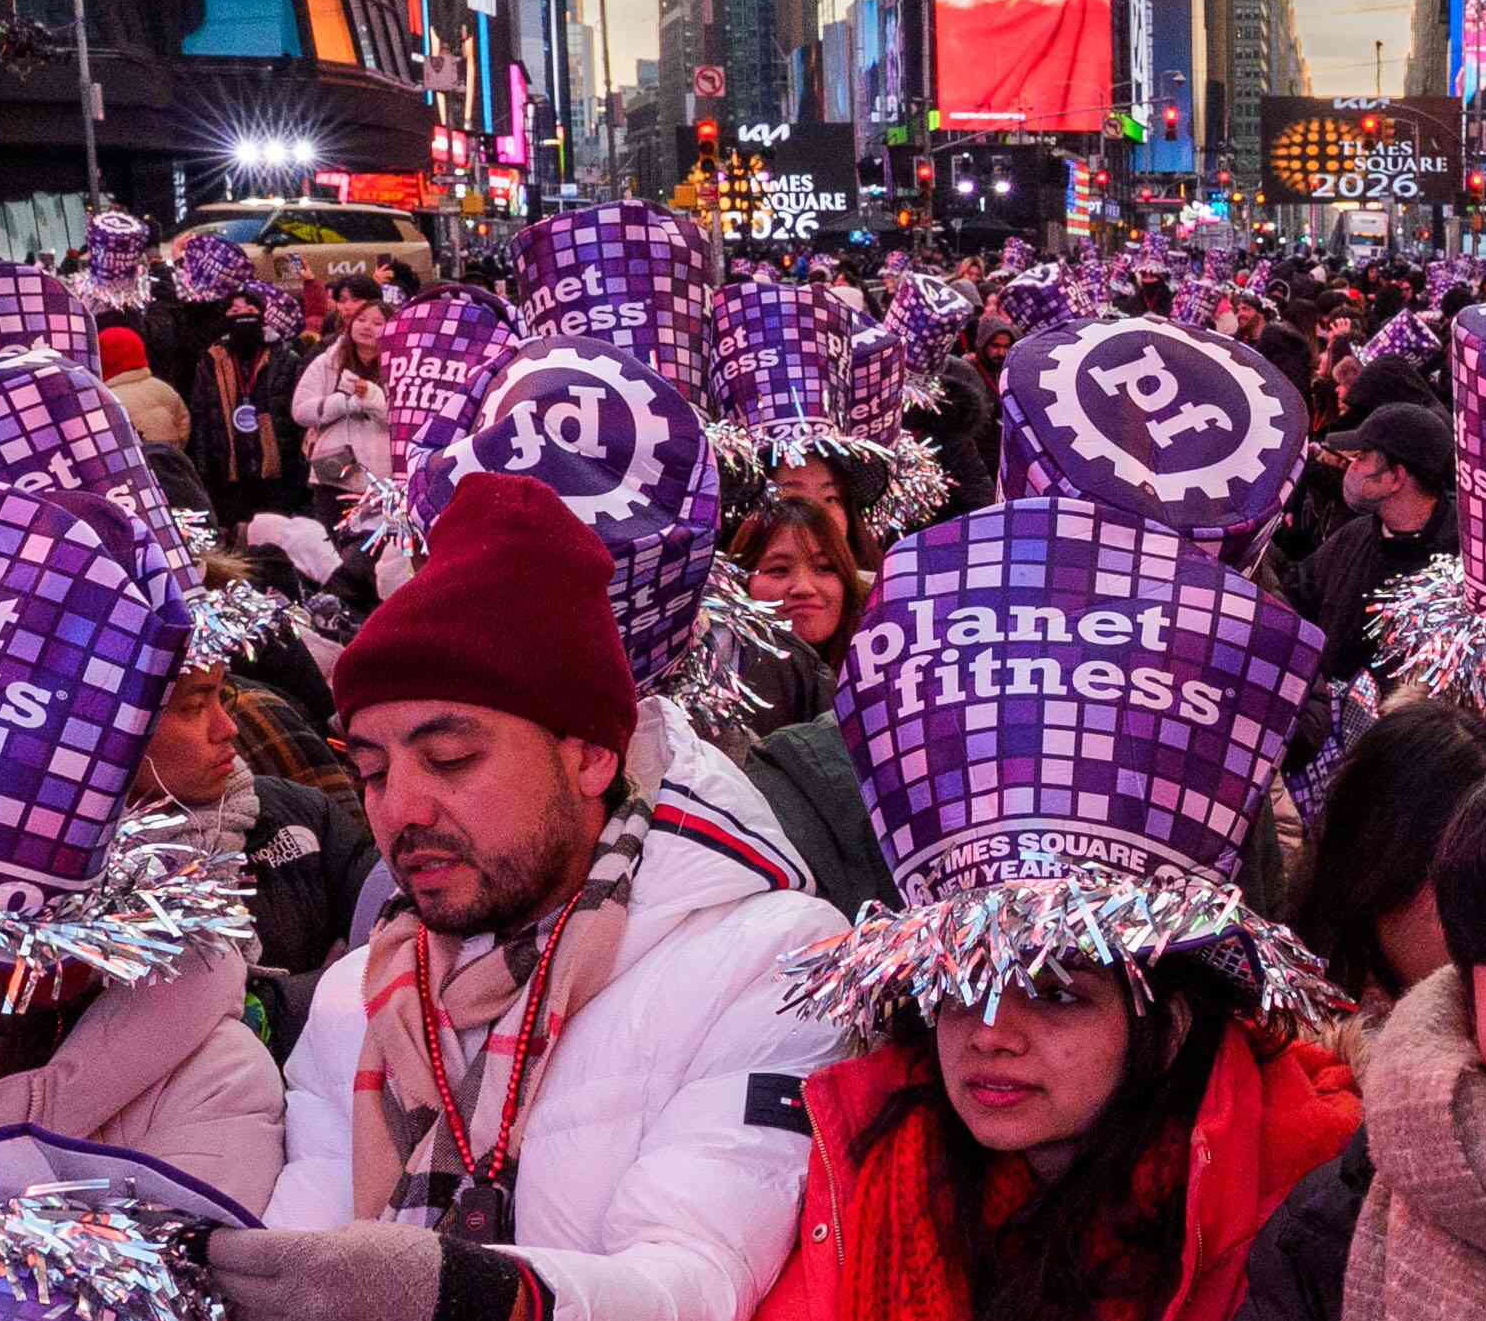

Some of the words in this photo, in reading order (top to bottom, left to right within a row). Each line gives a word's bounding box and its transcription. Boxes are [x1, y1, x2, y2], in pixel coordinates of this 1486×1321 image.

[1354, 156, 1447, 175] SQUARE
[1312, 174, 1417, 197] 2026
[851, 597, 1173, 693] planet
[894, 647, 1224, 726] fitness
[268, 850, 301, 870] FACE
[929, 833, 1011, 875] TIMES
[1018, 832, 1149, 874] SQUARE
